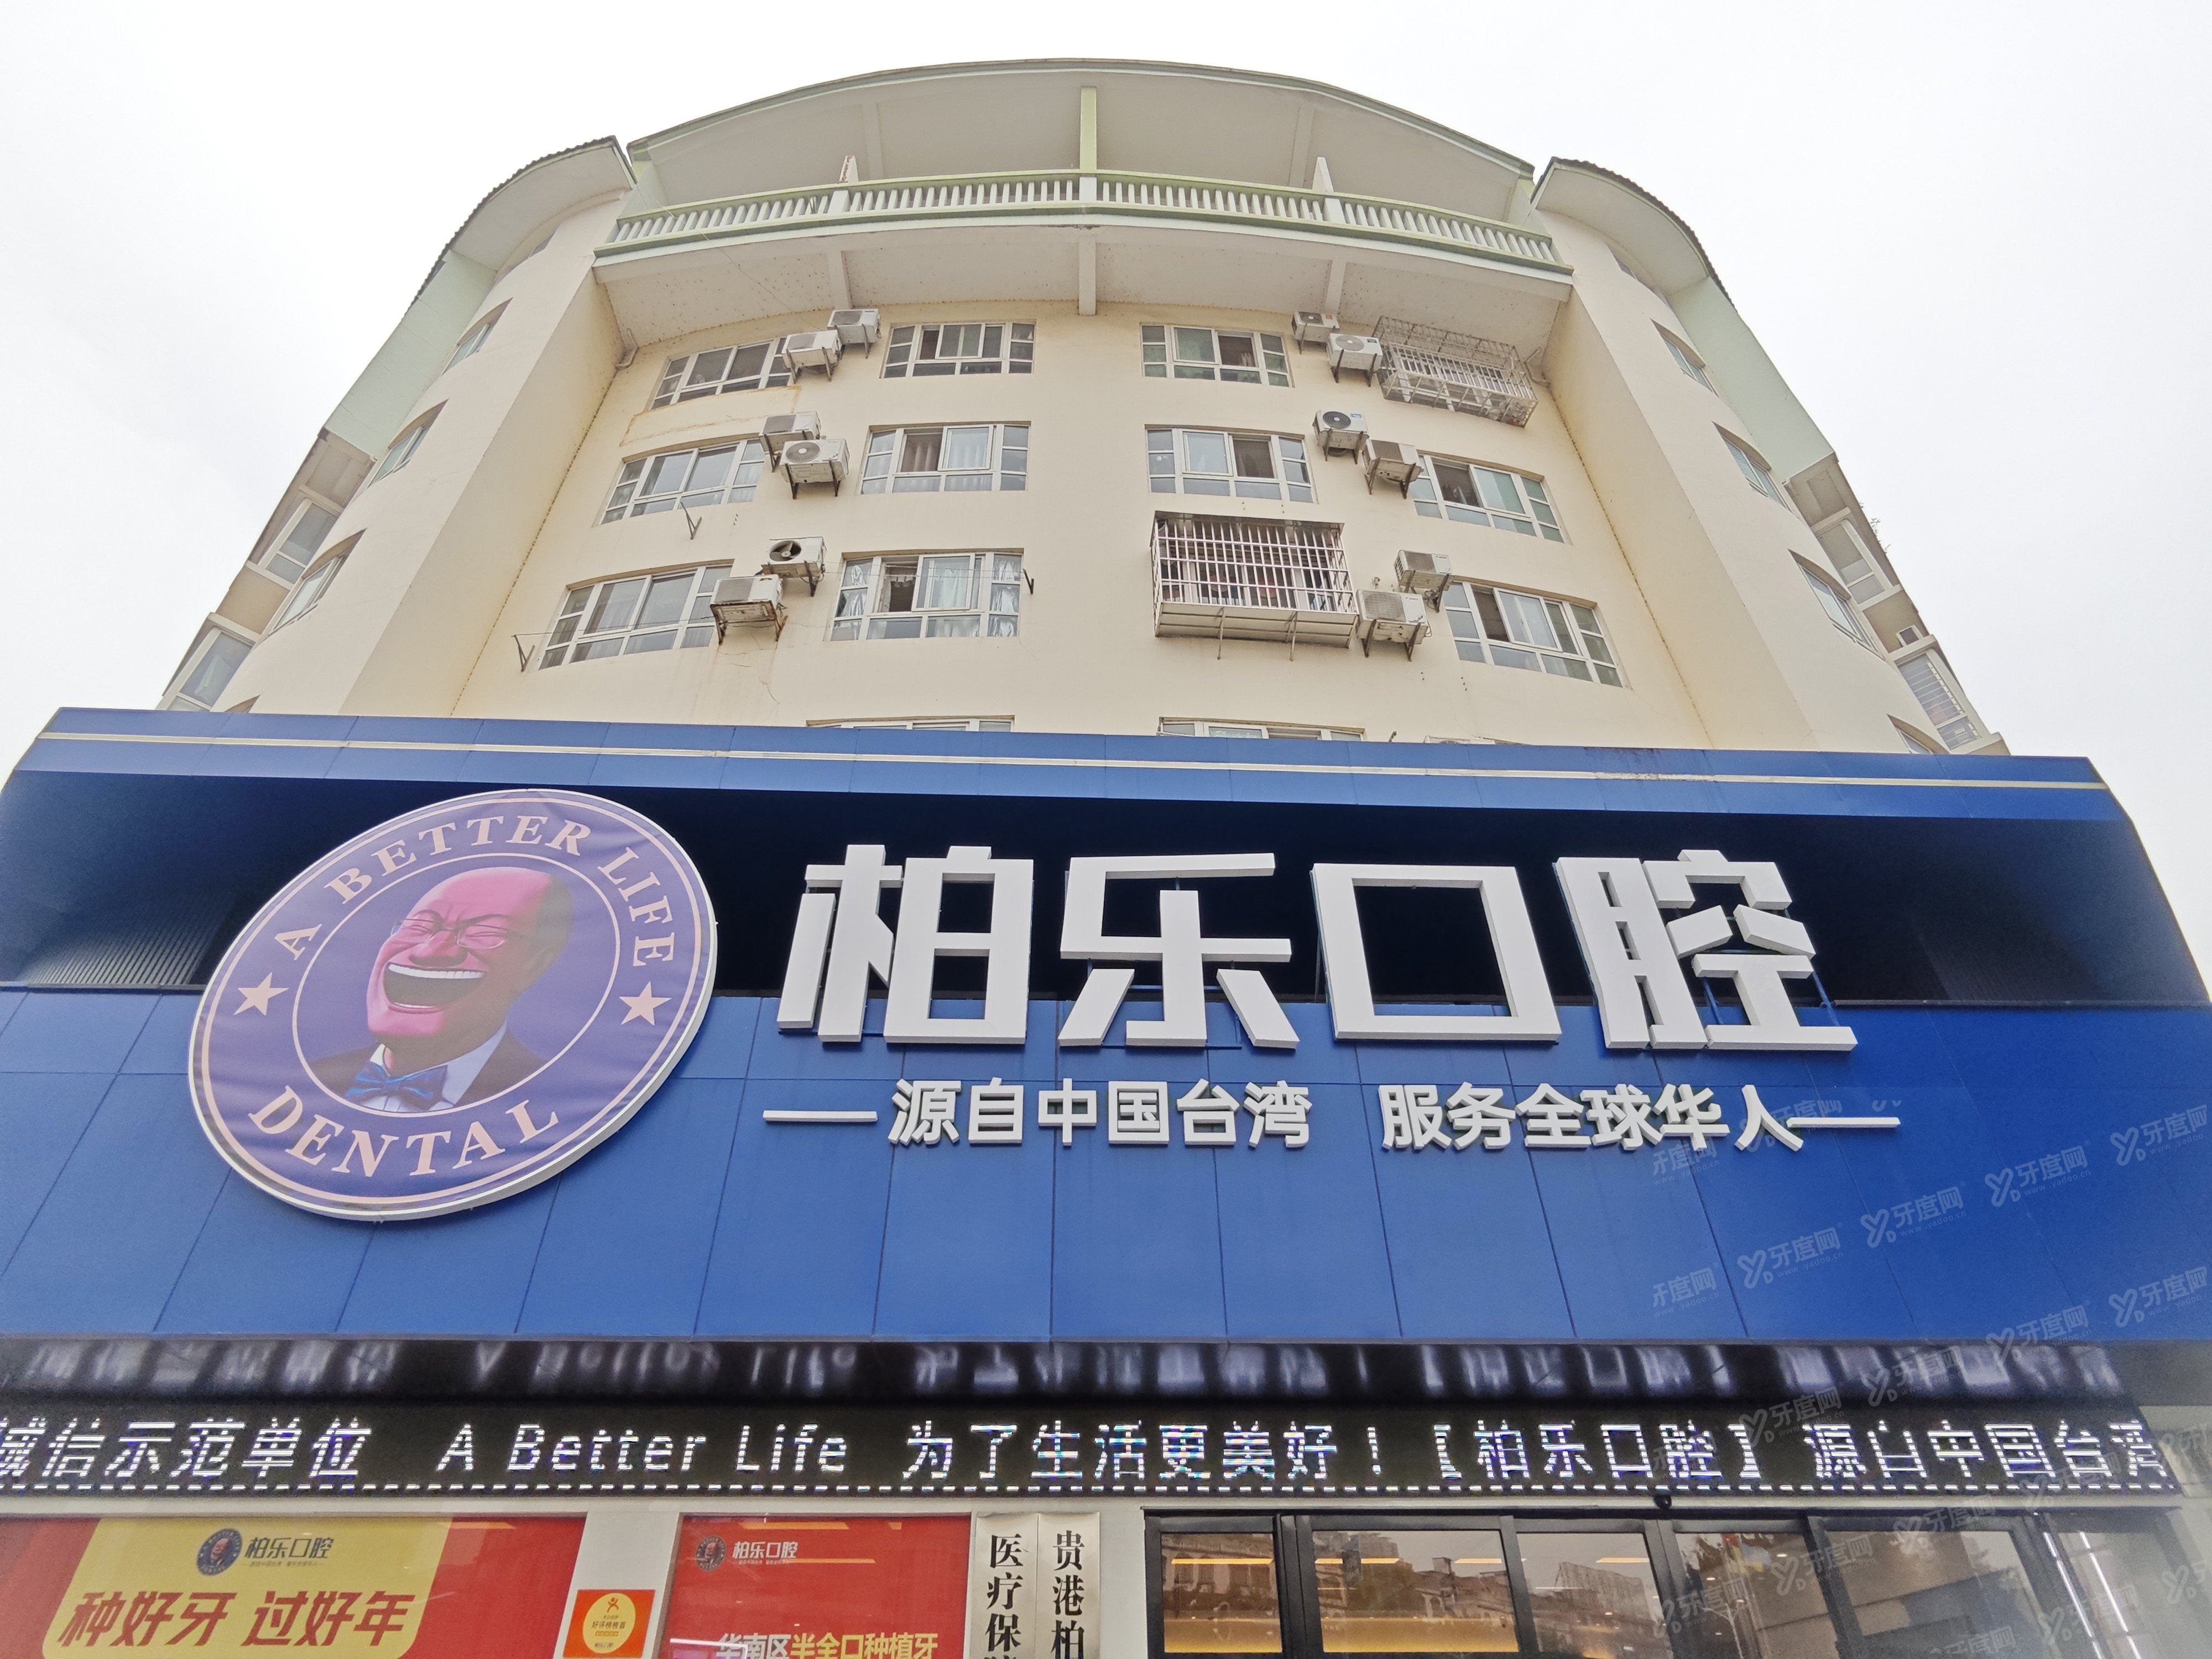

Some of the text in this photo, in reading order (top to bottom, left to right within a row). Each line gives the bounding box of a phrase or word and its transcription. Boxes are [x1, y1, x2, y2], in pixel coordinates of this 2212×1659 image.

[275, 815, 675, 968] A BETTER LIFE
[777, 844, 1857, 1051] 柏乐口腔
[248, 1086, 559, 1178] DENTAL
[888, 1077, 1803, 1151] 源自中国台湾 服务全球华人
[437, 1423, 474, 1472] A
[508, 1423, 706, 1472] Better
[735, 1423, 847, 1473] Life
[244, 1537, 334, 1559] 柏乐口腔
[732, 1541, 799, 1559] 柏乐口腔
[57, 1590, 415, 1647] 种好牙 过好年
[984, 1533, 1024, 1659] 医疗保
[1051, 1530, 1085, 1659] 贵港柏
